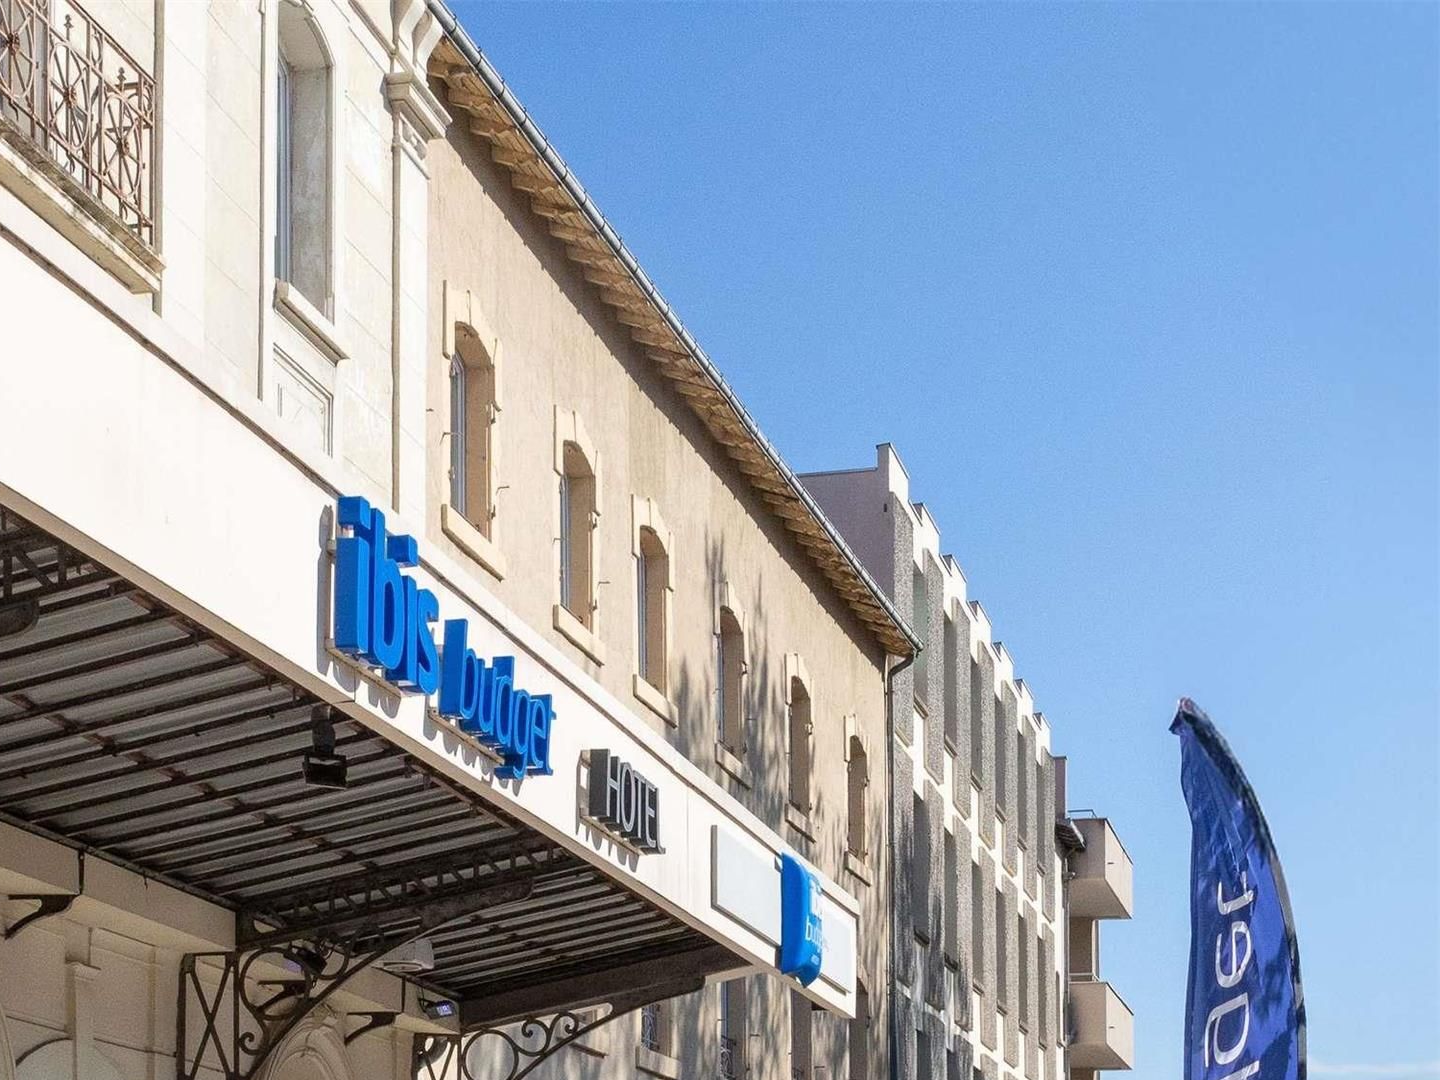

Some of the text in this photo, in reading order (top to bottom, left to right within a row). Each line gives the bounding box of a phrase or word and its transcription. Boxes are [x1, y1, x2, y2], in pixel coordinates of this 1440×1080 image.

[334, 496, 556, 780] ibis budget
[589, 748, 666, 854] HOTEL
